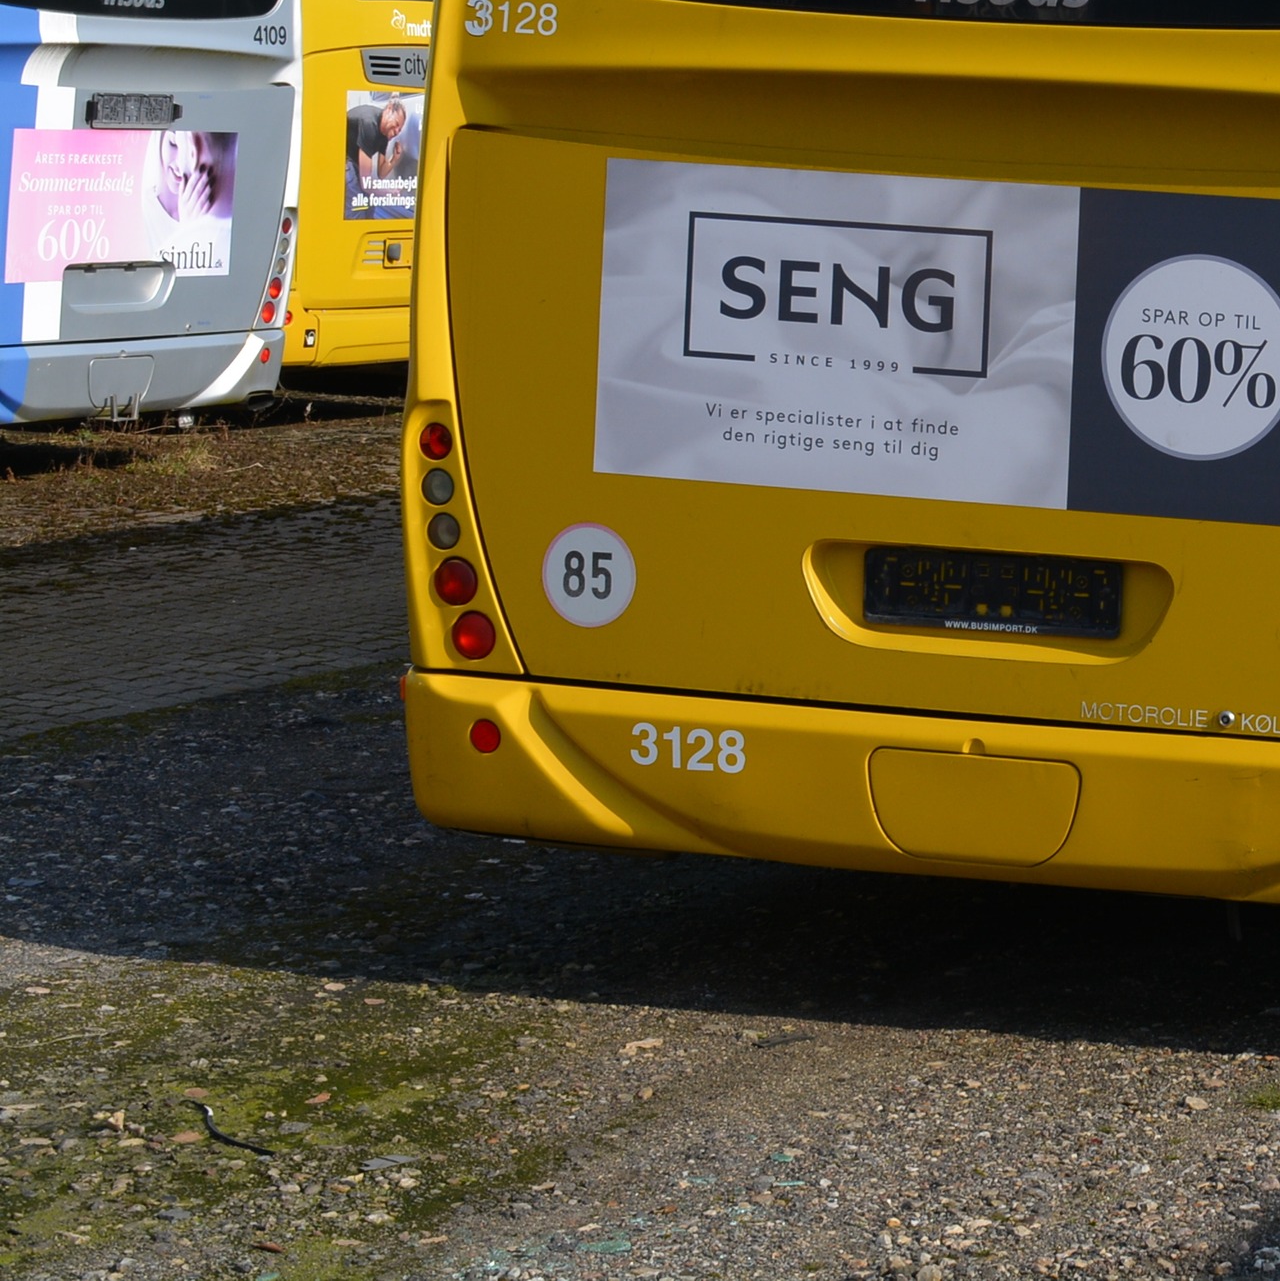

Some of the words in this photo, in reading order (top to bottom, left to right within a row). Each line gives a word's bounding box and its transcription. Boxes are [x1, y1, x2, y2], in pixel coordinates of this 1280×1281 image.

[253, 25, 287, 46] 4109
[35, 152, 66, 165] ÅRETS
[68, 154, 124, 165] FRÆKKESTE
[18, 171, 135, 197] Sommerudsalg
[362, 176, 372, 190] Vi
[47, 204, 72, 216] SPAR
[74, 205, 89, 216] OP
[90, 205, 105, 216] TIL
[351, 193, 369, 207] alle
[369, 193, 416, 209] forsikrings
[37, 218, 110, 262] 60%
[719, 255, 956, 333] SENG
[1141, 308, 1189, 326] SPAR
[1198, 312, 1226, 327] OP
[1234, 314, 1262, 331] TIL
[769, 353, 834, 368] SINCE
[849, 358, 900, 373] 1999
[1120, 333, 1277, 409] 60%
[706, 402, 722, 418] Vi
[730, 408, 748, 419] er
[755, 409, 863, 429] specialister
[870, 415, 876, 429] i
[884, 418, 903, 432] at
[911, 418, 960, 436] finde
[723, 427, 755, 442] den
[764, 430, 825, 451] rigtige
[832, 439, 875, 456] seng
[884, 439, 902, 454] til
[911, 441, 940, 461] dig
[562, 550, 613, 600] 85
[944, 620, 1039, 634] WWW.BUSIMPORT.DK
[1080, 701, 1209, 728] MOTOROLIE
[630, 722, 747, 774] 3128
